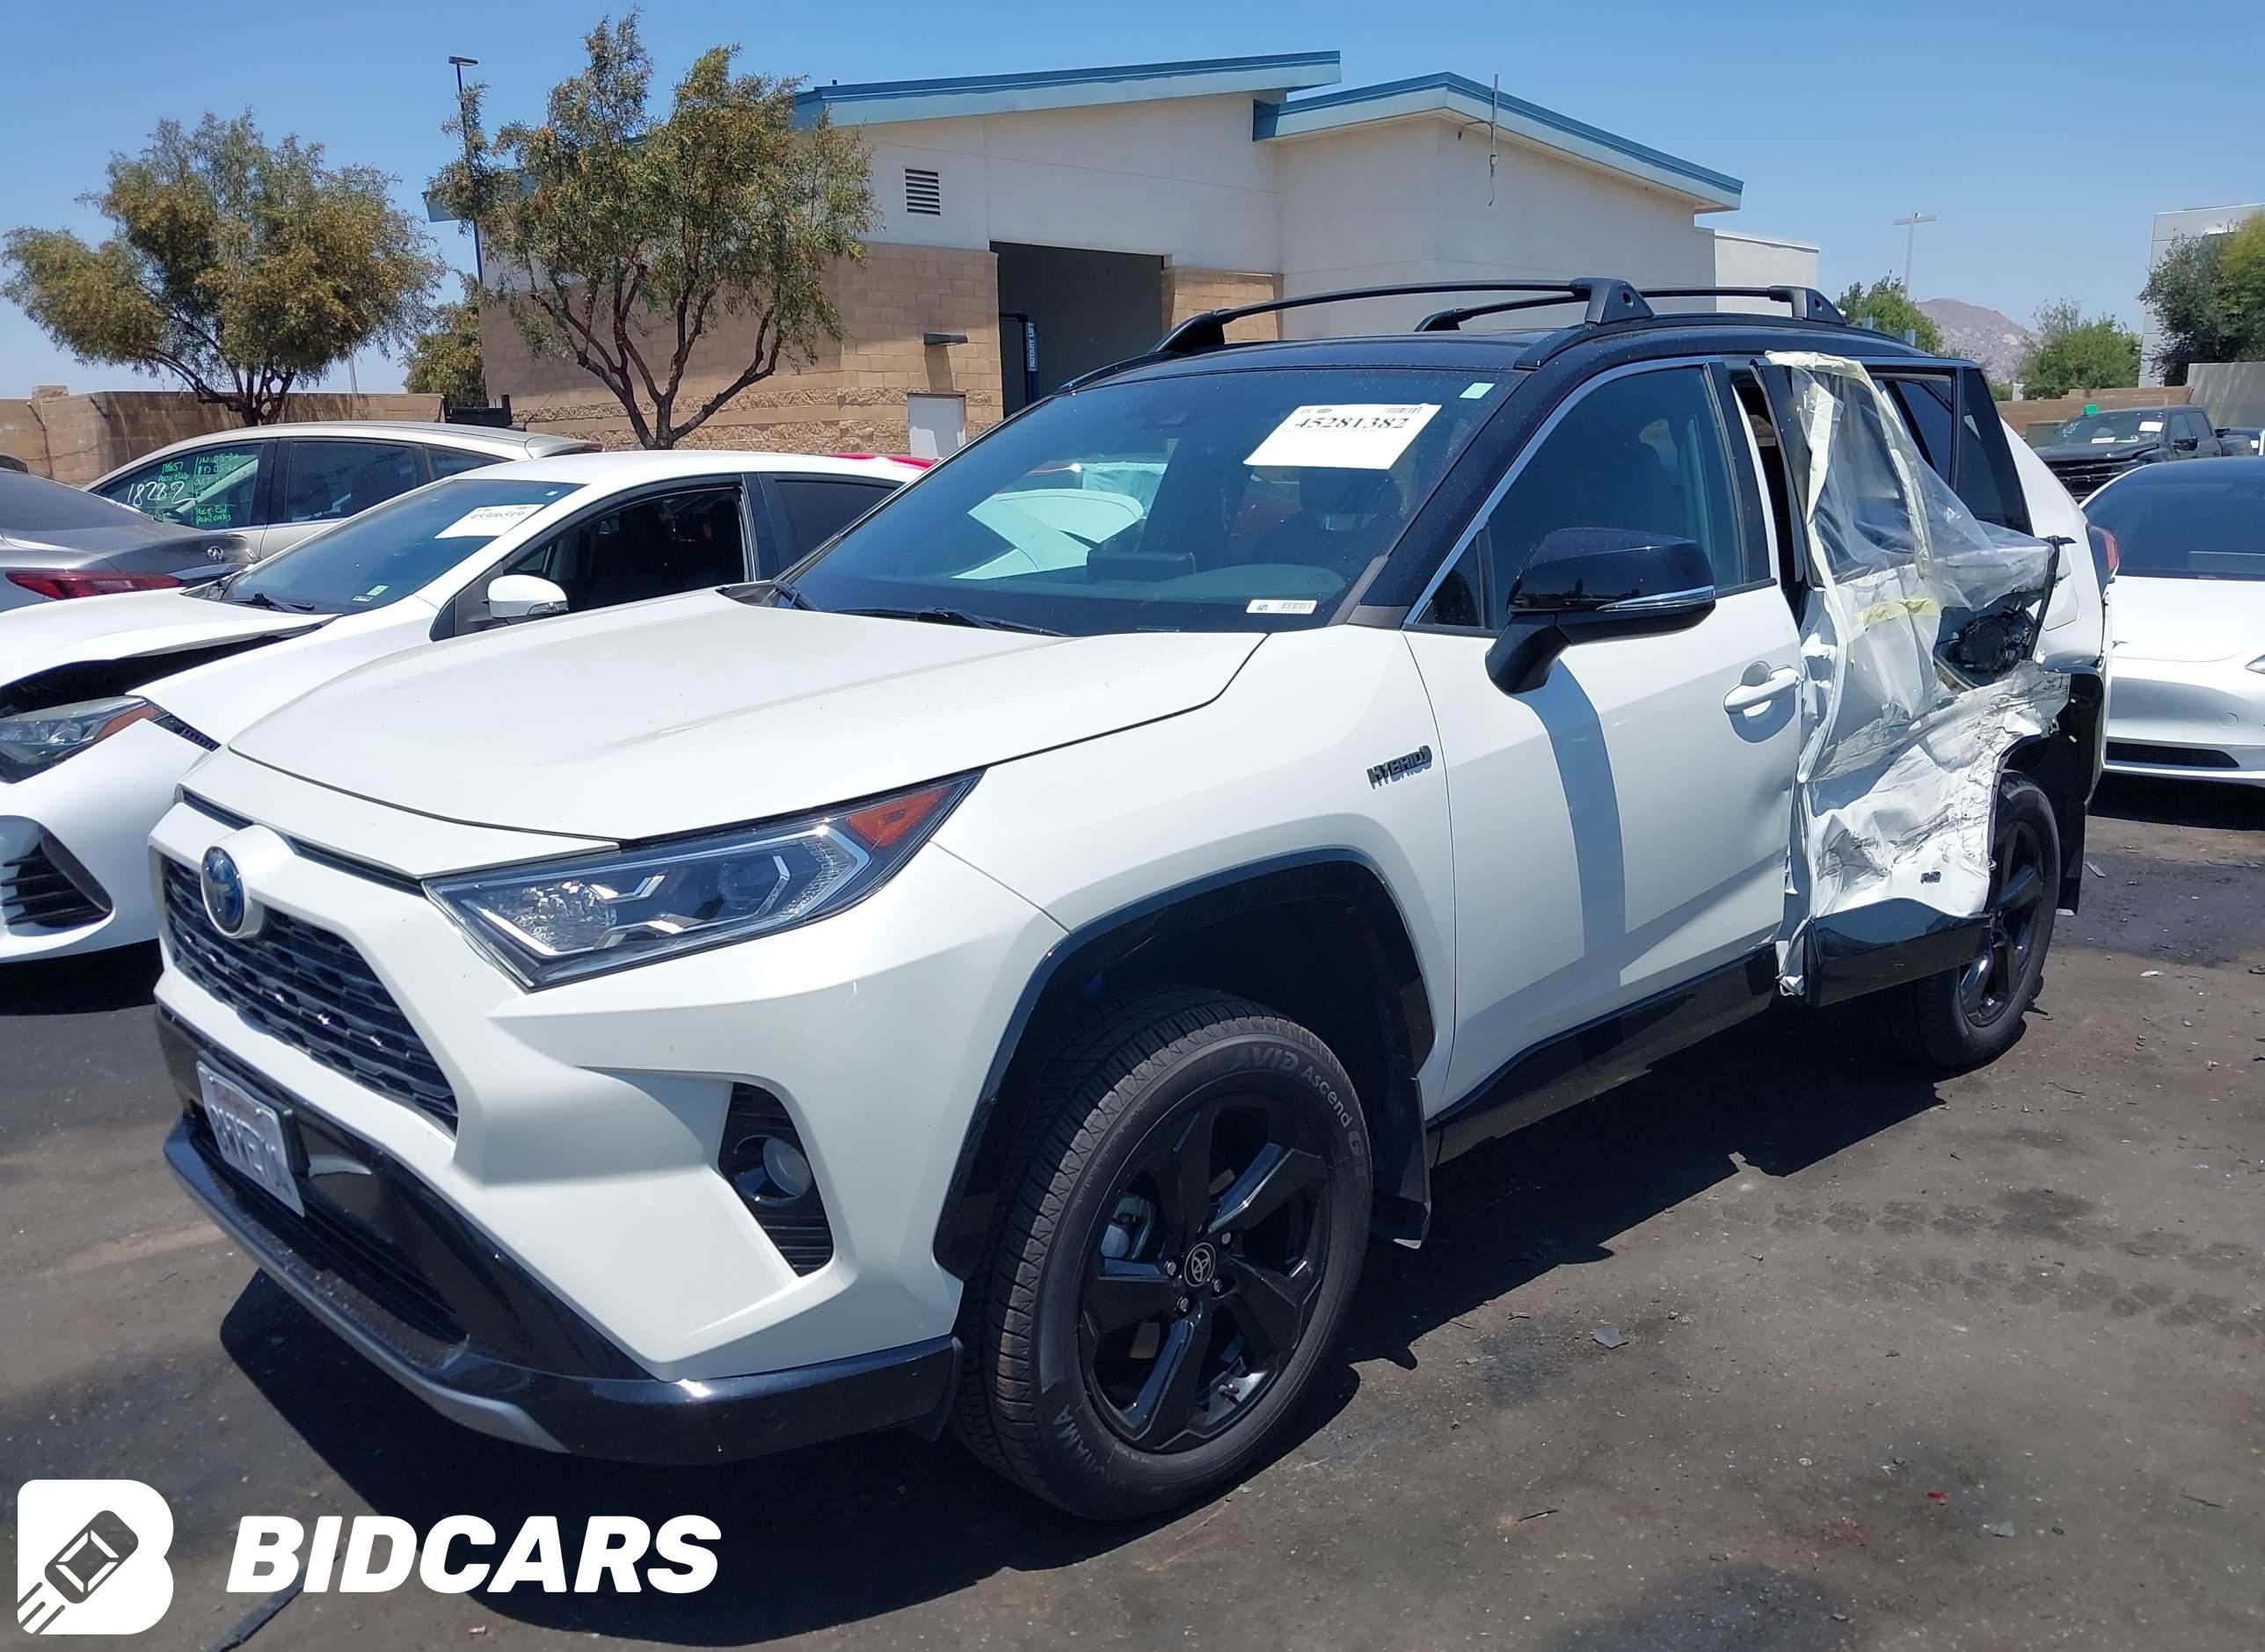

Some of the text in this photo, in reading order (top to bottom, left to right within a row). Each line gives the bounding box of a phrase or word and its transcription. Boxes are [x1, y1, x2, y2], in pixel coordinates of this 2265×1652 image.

[1294, 418, 1409, 429] 45281382
[1366, 745, 1432, 790] HYBRID
[1231, 1046, 1300, 1072] AVID
[1300, 1065, 1353, 1127] Ascend
